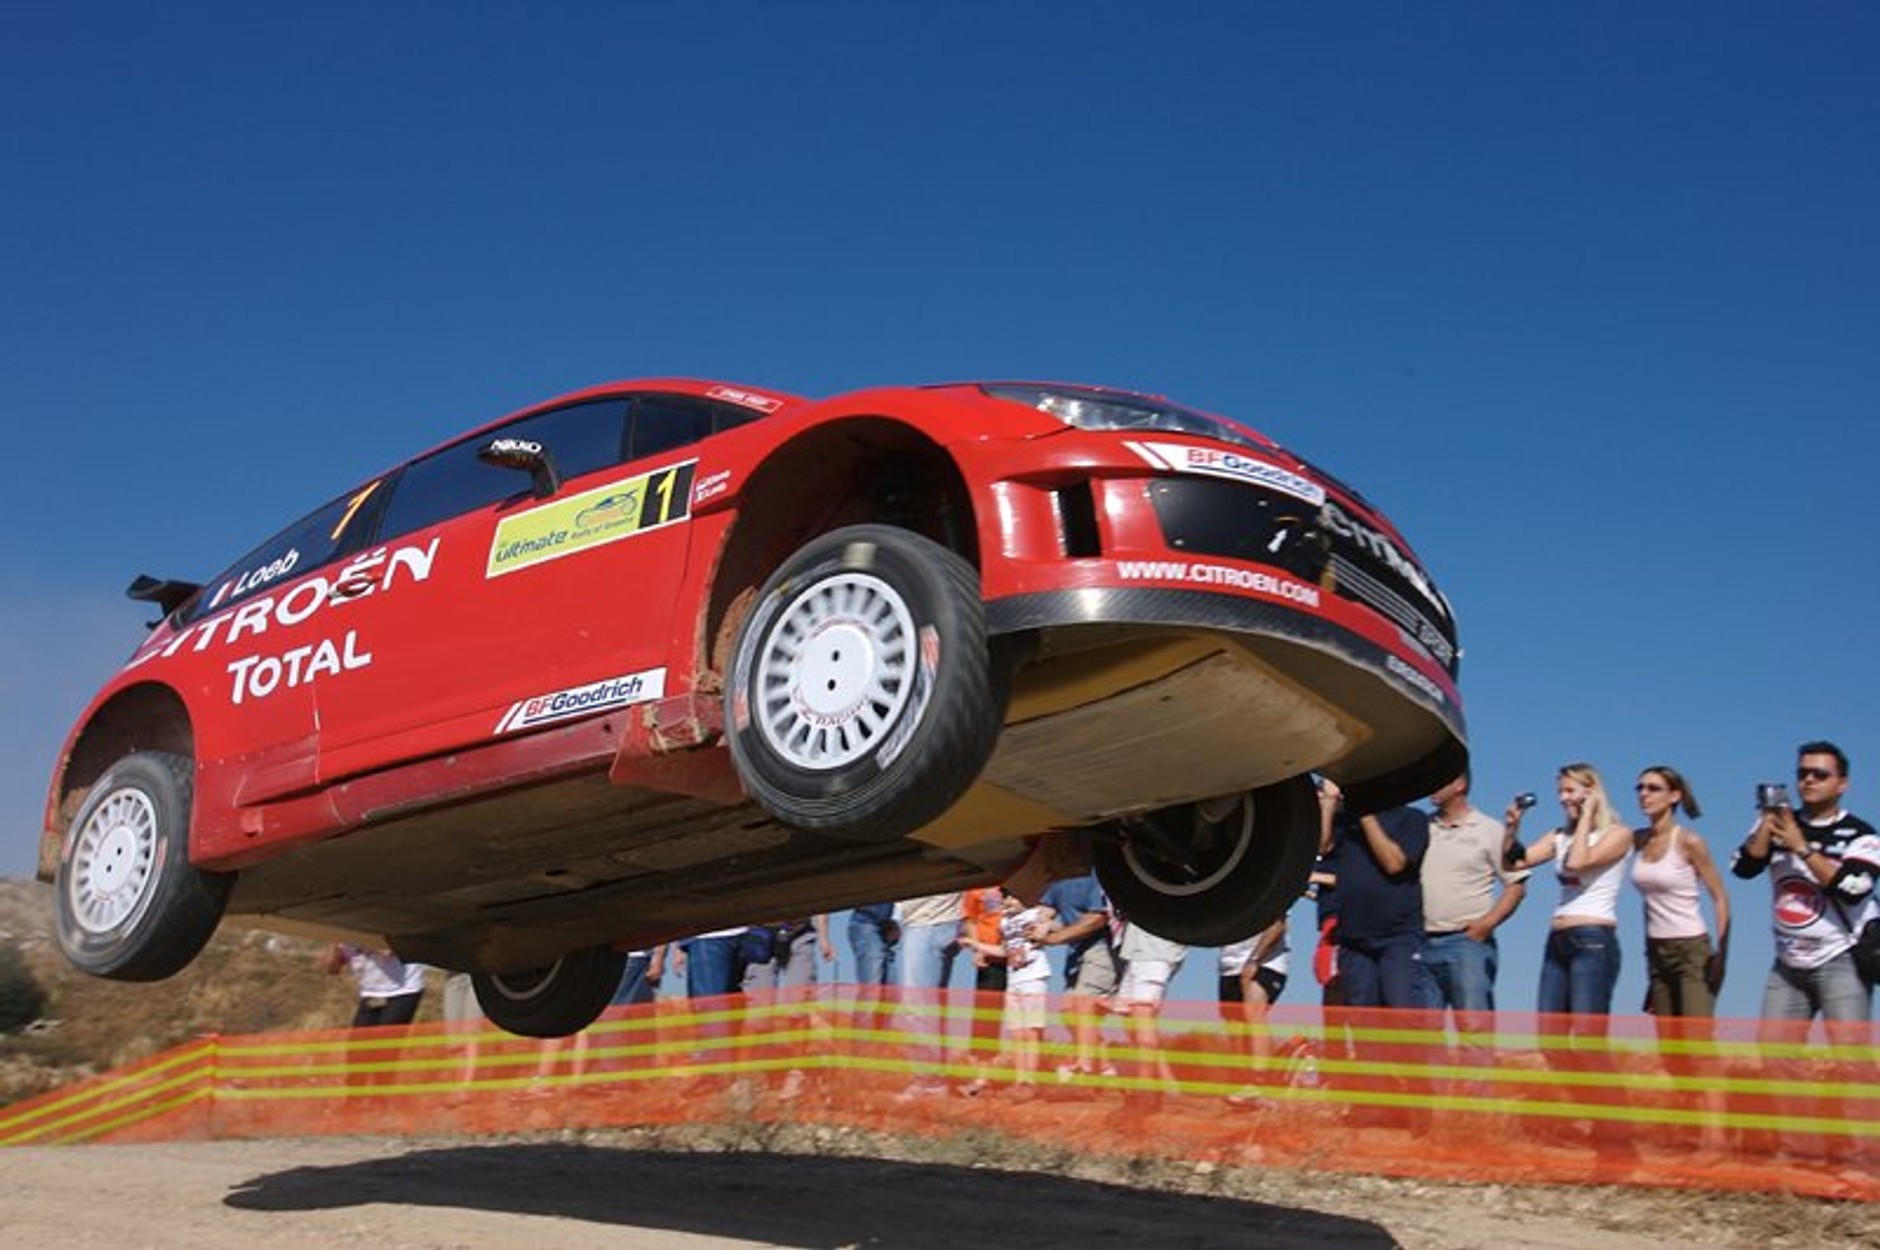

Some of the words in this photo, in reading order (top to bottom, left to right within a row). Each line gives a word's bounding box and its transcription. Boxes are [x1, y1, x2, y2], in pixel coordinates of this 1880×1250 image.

[654, 467, 679, 523] 1
[230, 547, 299, 598] Loeb
[227, 630, 372, 705] TOTAL
[524, 677, 643, 718] BFGoodrich
